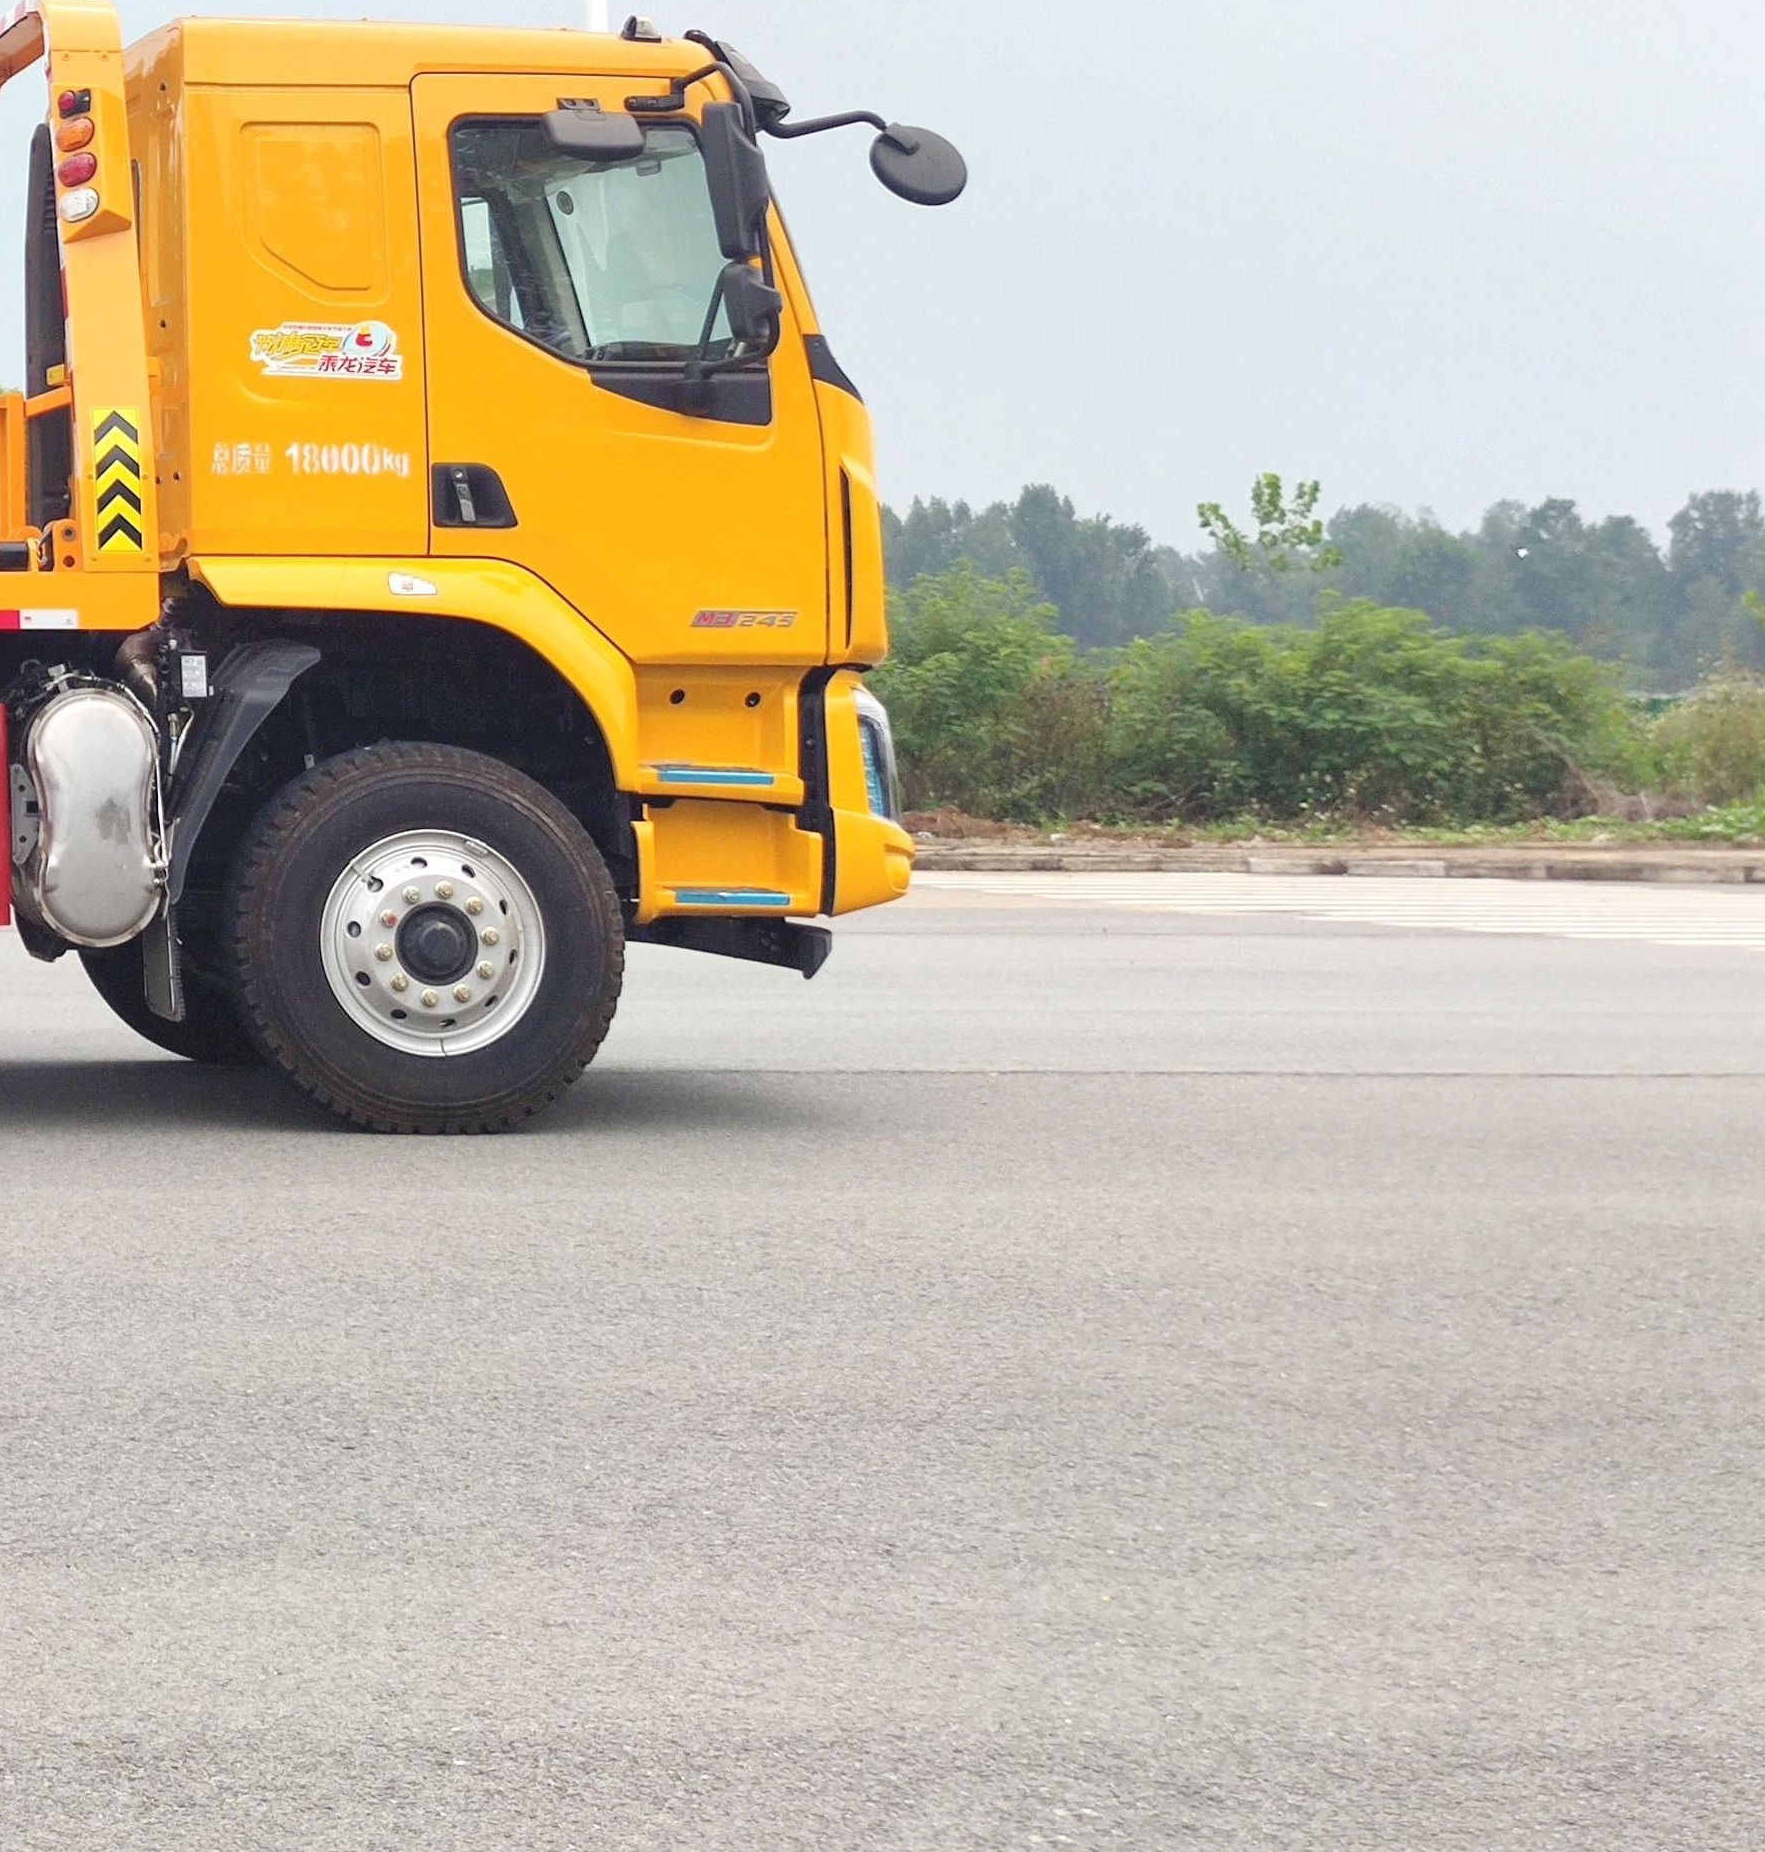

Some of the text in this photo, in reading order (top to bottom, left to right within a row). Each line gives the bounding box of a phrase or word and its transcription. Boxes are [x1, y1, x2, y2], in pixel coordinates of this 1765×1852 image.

[319, 354, 398, 374] 乘龙汽车
[212, 442, 410, 477] 总质量 18000kg
